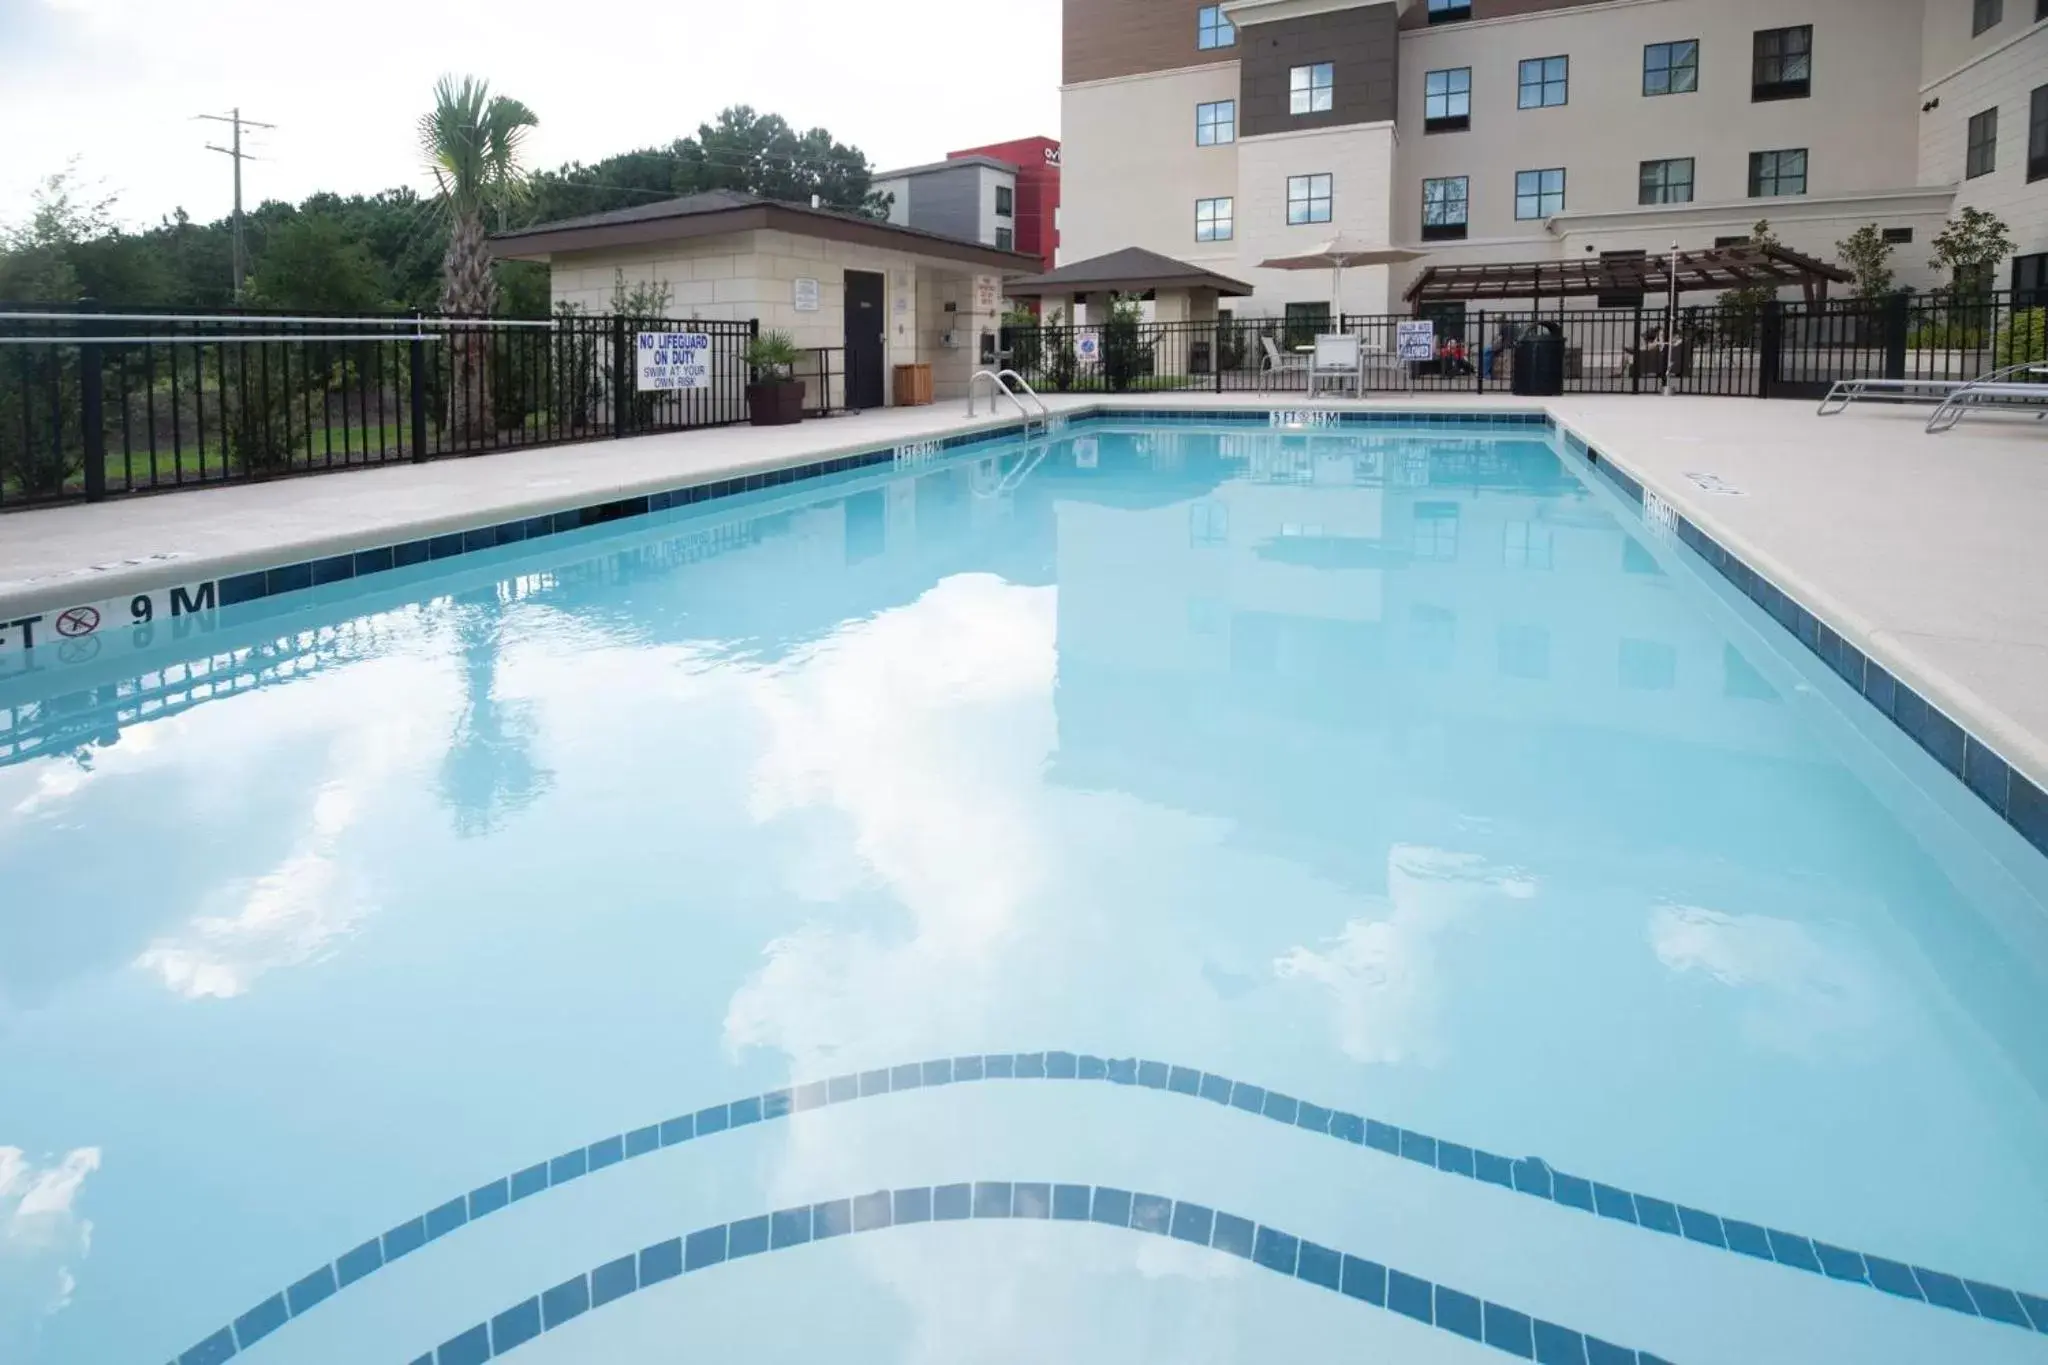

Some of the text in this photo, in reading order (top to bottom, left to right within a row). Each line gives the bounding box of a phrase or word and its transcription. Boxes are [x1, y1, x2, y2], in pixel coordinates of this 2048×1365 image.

[640, 334, 708, 349] NO LIFEGUARD
[654, 350, 696, 365] ON DUTY
[644, 365, 705, 378] SWIM AT YOUR
[654, 376, 696, 388] OWN RISK
[1284, 411, 1296, 424] FT
[130, 594, 154, 625] 9
[170, 581, 215, 616] M
